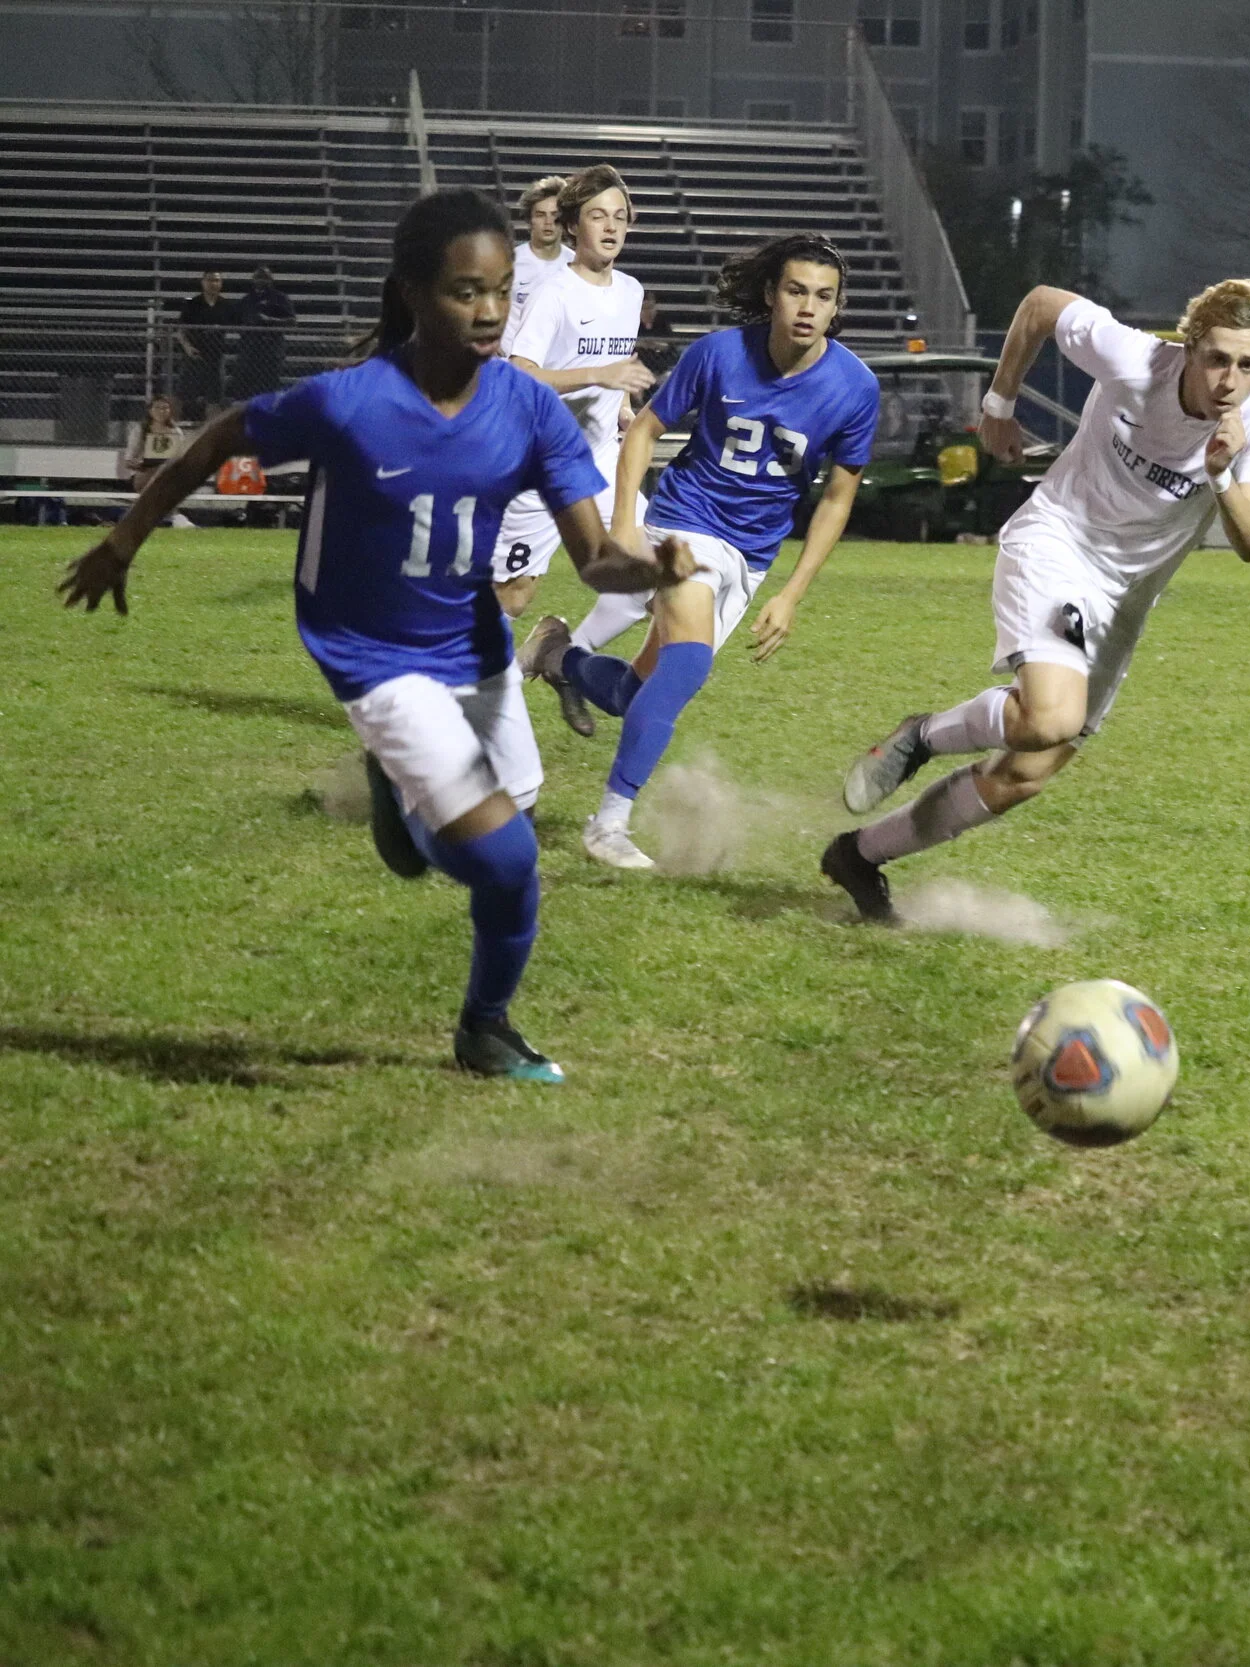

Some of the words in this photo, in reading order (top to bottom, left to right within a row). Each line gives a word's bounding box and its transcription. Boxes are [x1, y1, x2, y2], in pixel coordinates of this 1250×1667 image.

[577, 338, 605, 355] GULF
[720, 415, 808, 476] 23
[1112, 434, 1146, 471] GULF
[401, 494, 477, 577] 11
[506, 542, 531, 573] 8
